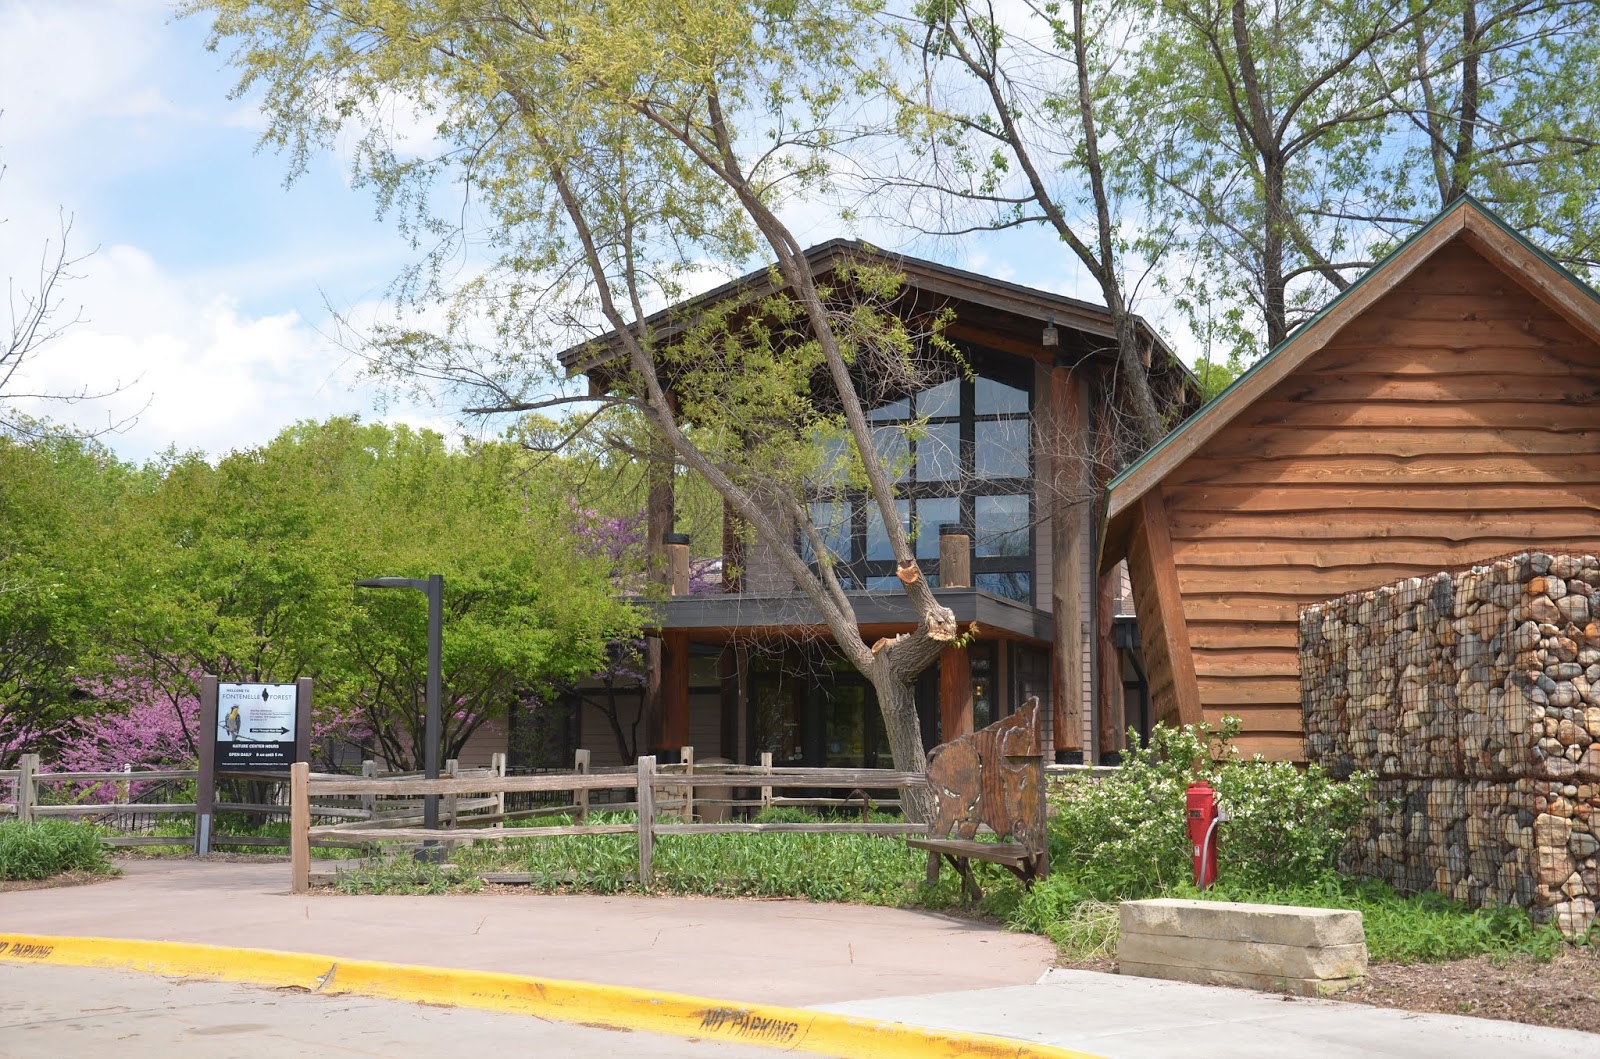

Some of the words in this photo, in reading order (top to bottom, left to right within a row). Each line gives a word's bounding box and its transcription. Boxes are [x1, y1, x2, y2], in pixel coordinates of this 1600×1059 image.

[8, 943, 54, 959] PARKING
[698, 1008, 726, 1032] NO
[727, 1012, 798, 1043] PARKING
